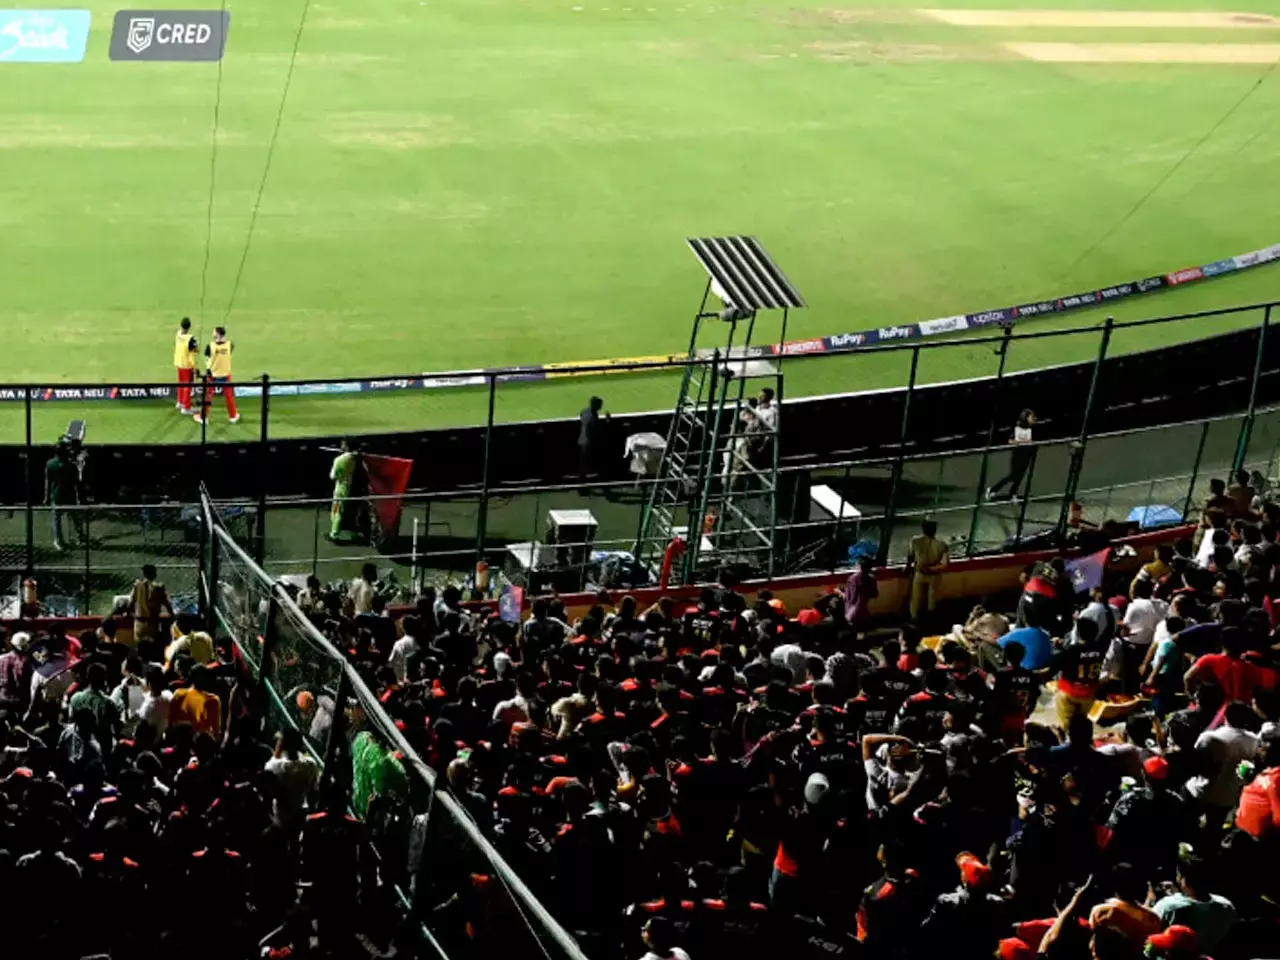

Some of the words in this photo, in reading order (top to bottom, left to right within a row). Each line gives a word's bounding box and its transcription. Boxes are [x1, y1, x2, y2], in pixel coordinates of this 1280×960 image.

[156, 23, 212, 44] CRED
[55, 389, 82, 398] TATA
[84, 388, 105, 397] NEU
[121, 388, 148, 398] TATA
[150, 387, 171, 396] NEU
